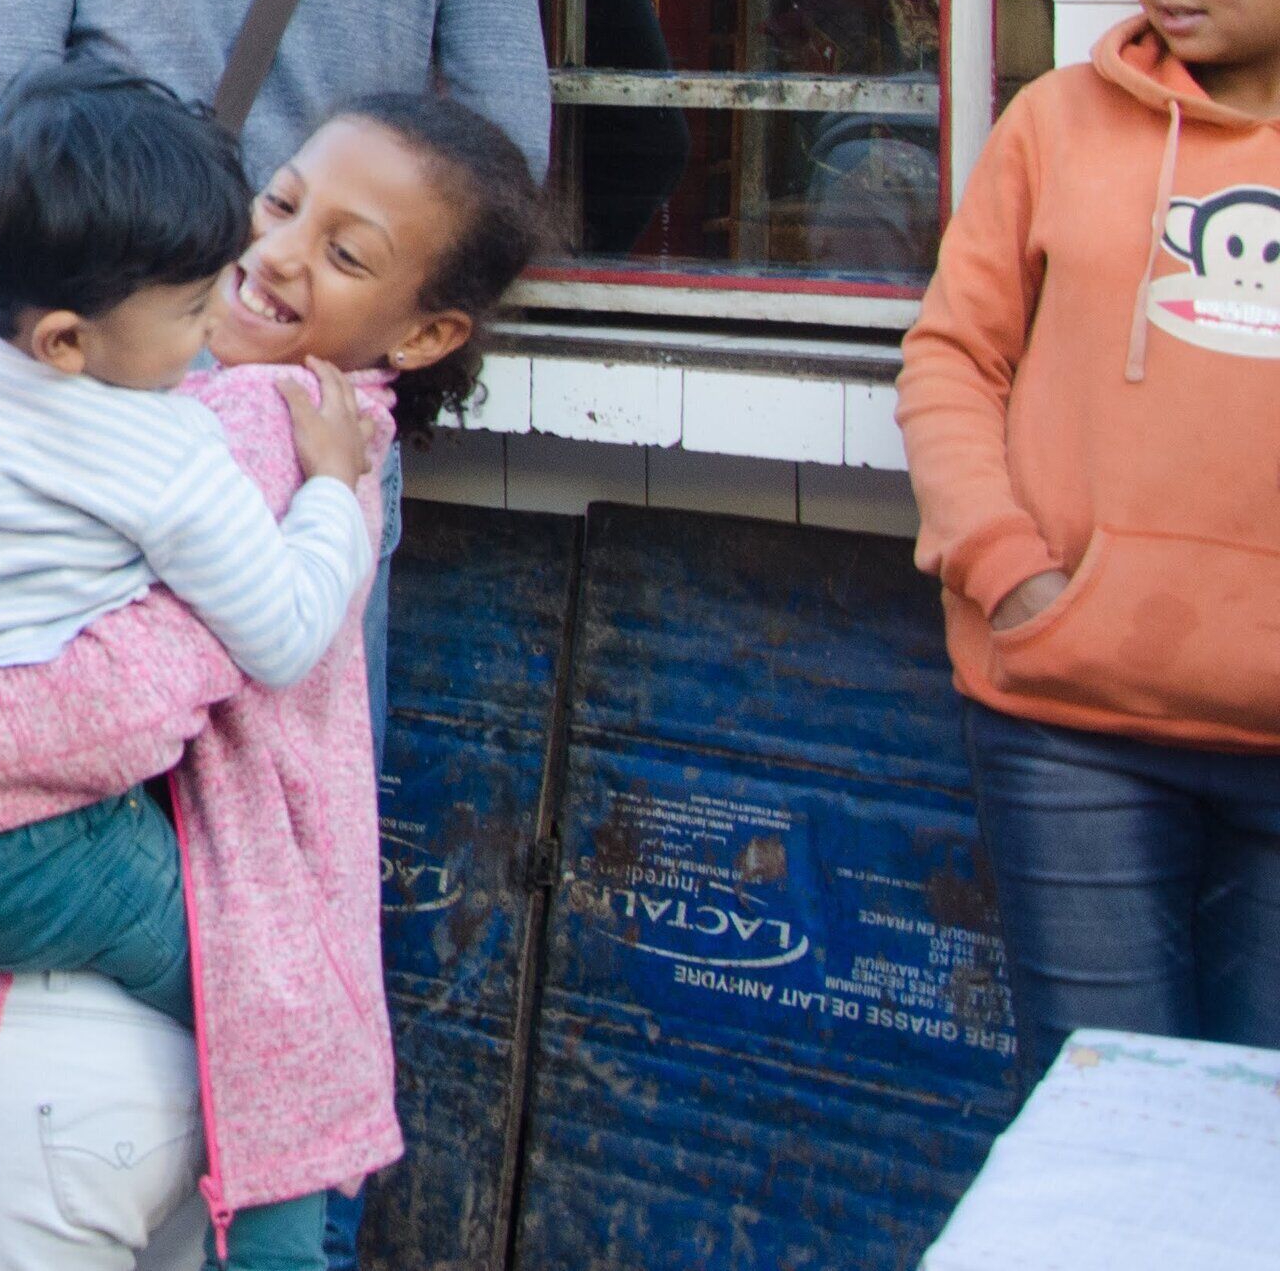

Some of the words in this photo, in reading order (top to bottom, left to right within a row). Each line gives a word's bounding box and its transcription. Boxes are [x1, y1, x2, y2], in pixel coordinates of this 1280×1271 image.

[672, 963, 774, 1002] ANHYDRE
[778, 988, 827, 1013] LAIT
[831, 996, 860, 1021] DE
[865, 1005, 959, 1042] GRASSE
[963, 1025, 1018, 1058] IÈRE
